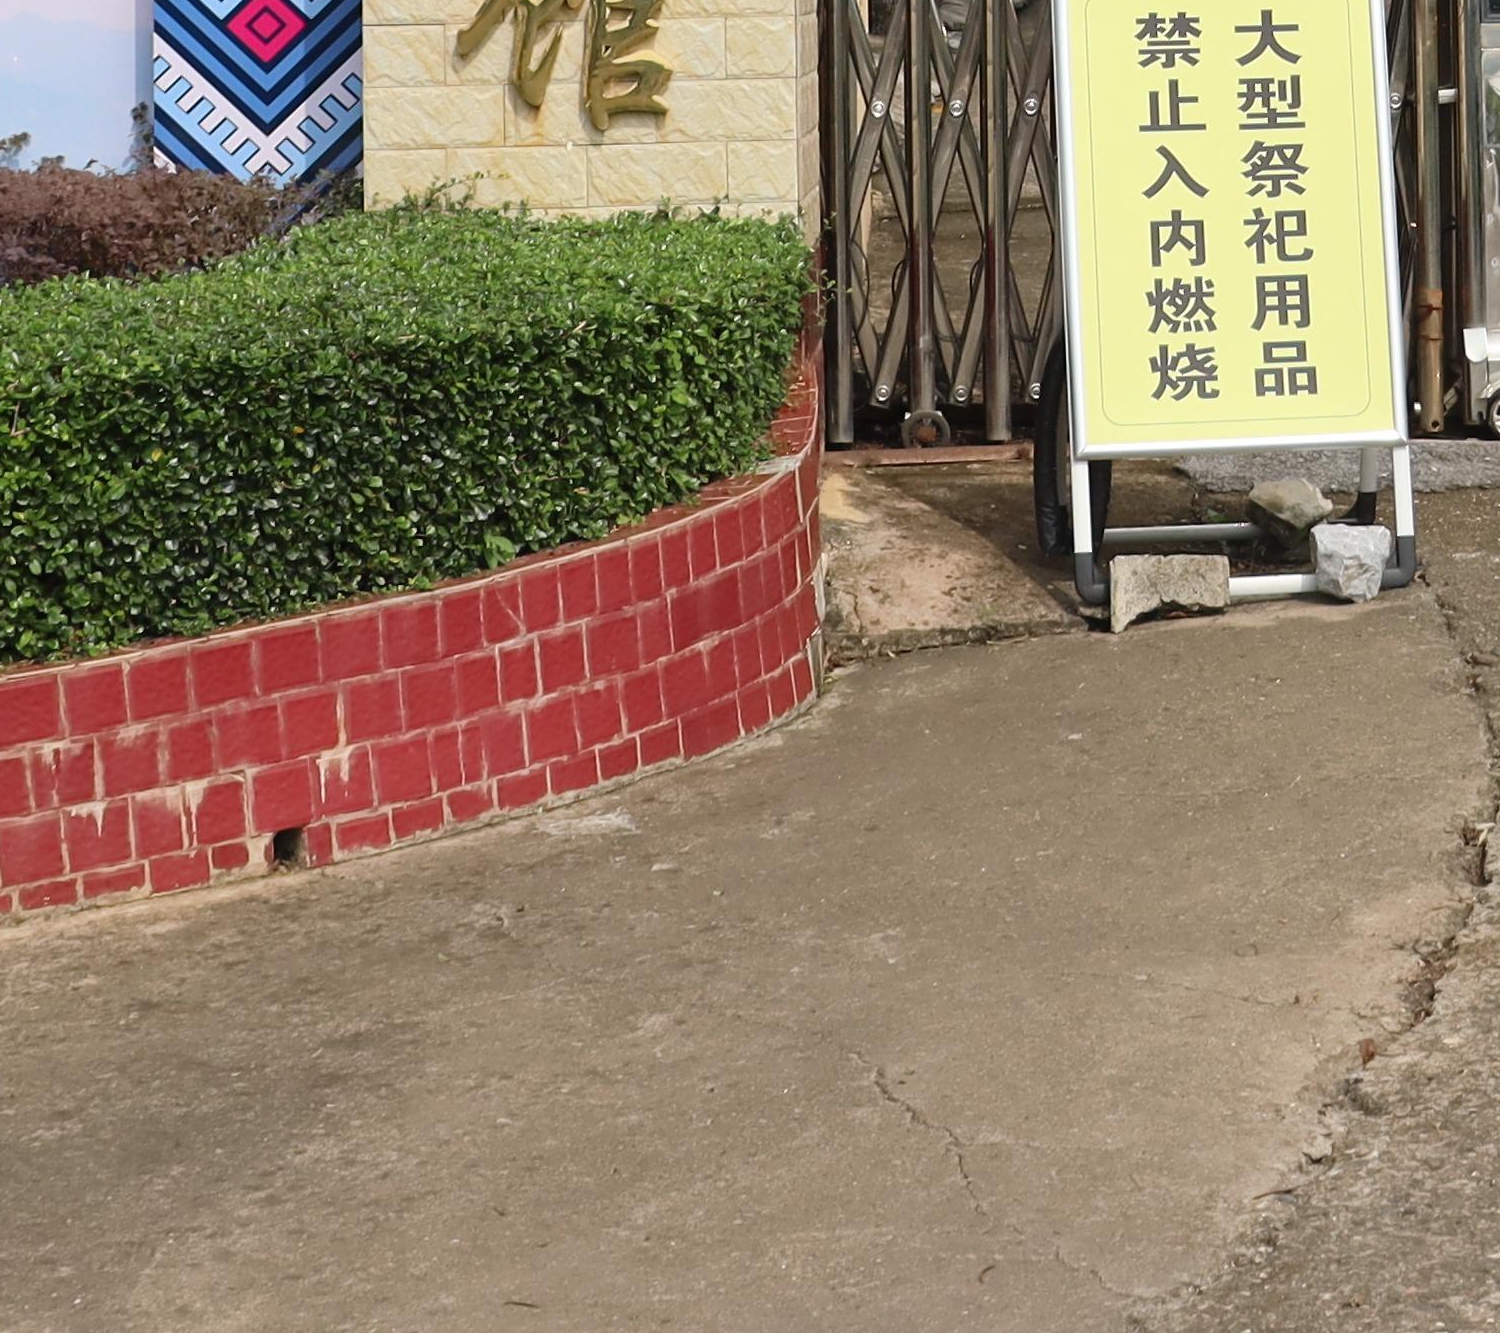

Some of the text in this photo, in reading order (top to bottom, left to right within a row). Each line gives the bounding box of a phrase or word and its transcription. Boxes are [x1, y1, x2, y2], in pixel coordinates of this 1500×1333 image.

[1135, 12, 1220, 402] 禁止入内燃烧
[1234, 9, 1319, 398] 大型祭祀用品
